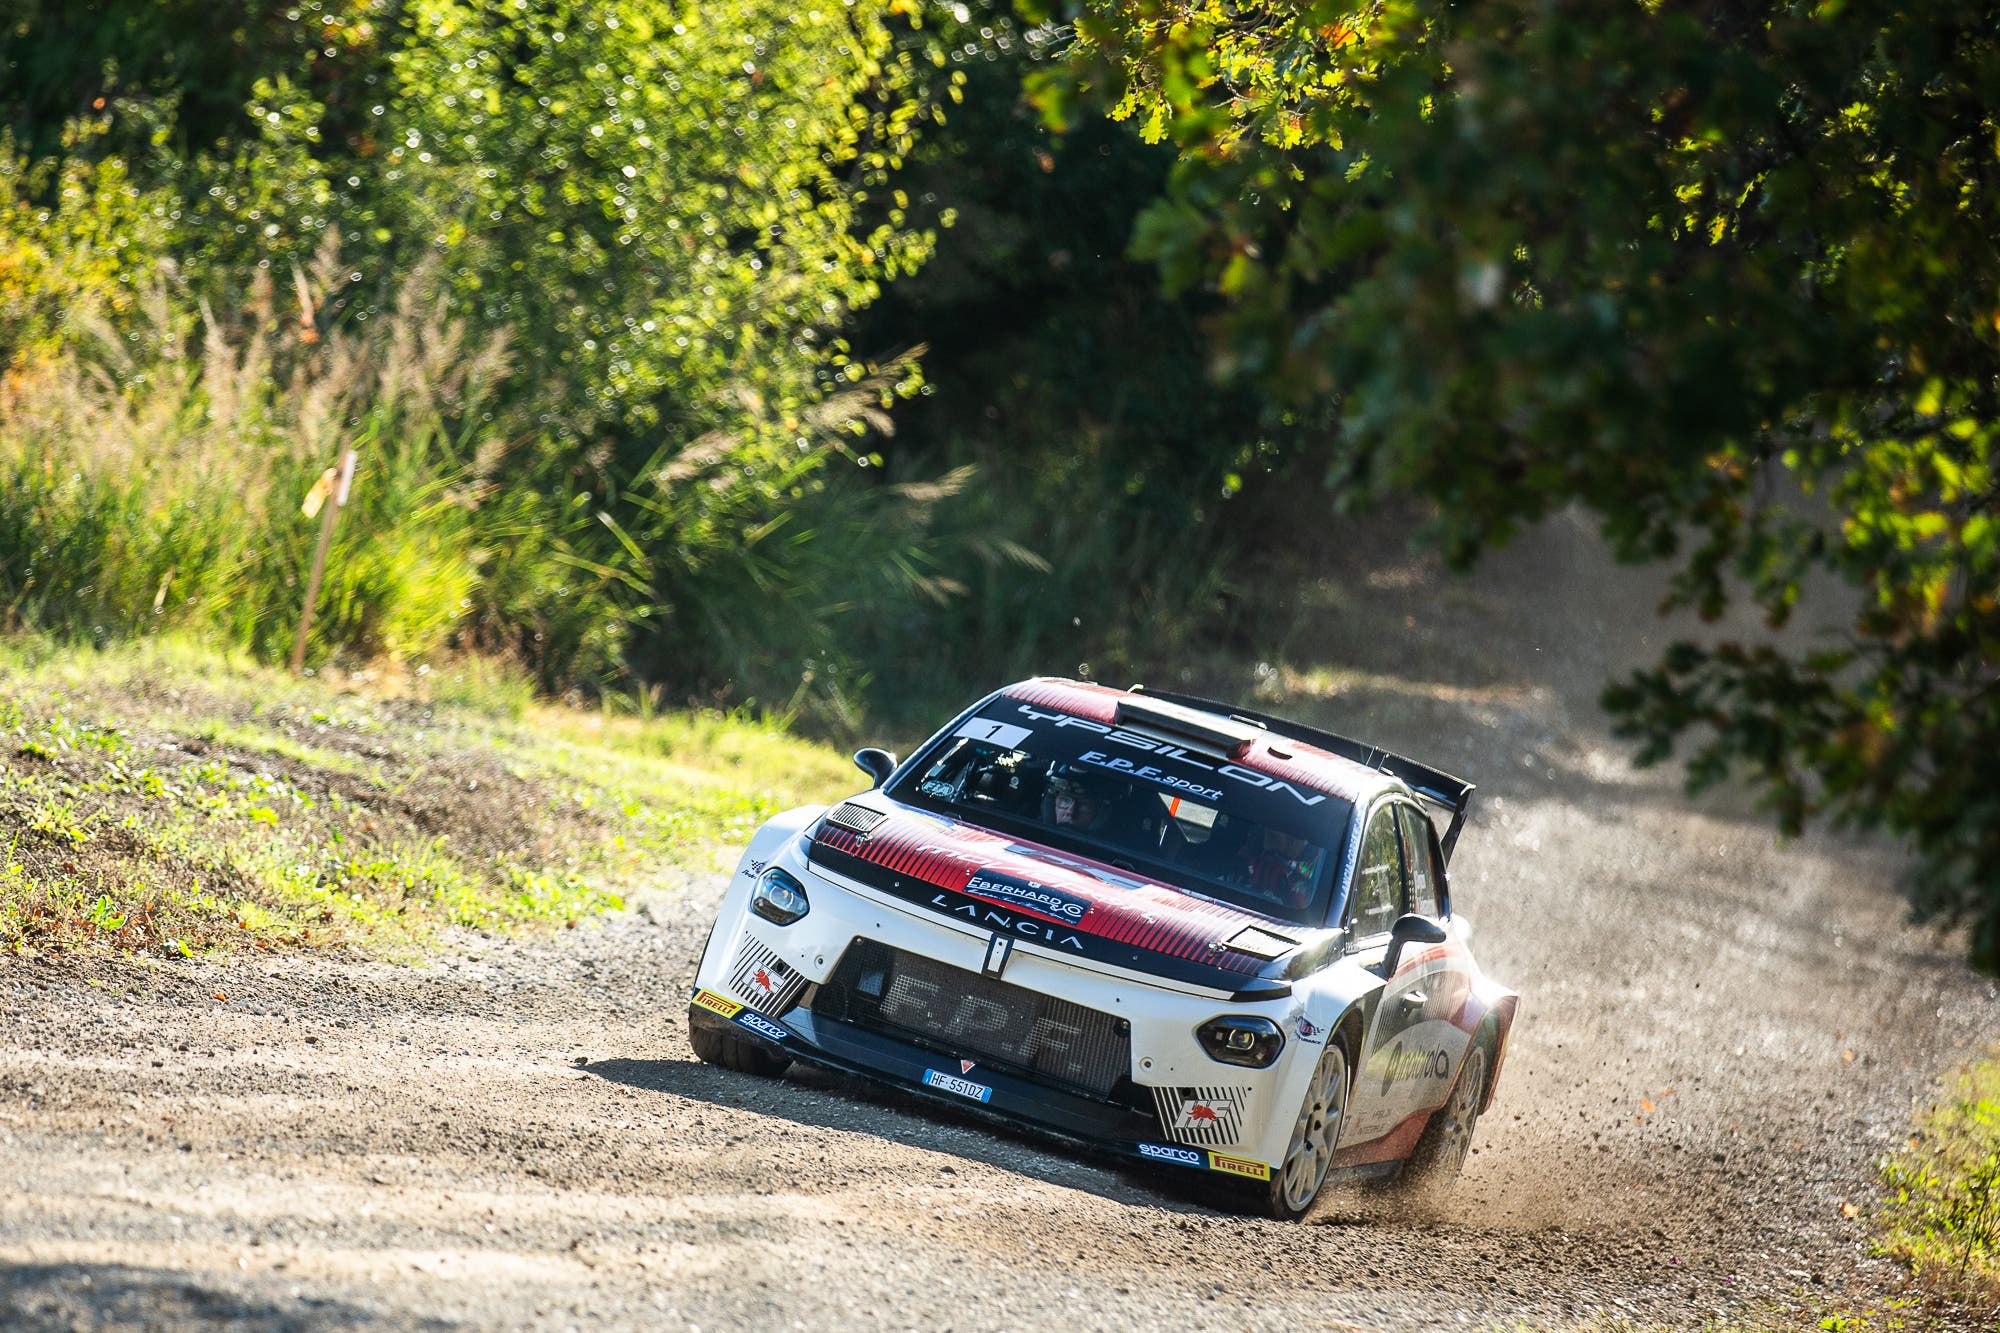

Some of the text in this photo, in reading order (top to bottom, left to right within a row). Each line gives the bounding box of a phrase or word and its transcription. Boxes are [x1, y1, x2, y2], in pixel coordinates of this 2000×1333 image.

[985, 724, 1003, 739] 1
[1018, 704, 1327, 806] YPSILON
[966, 876, 1062, 906] EBERHARD
[930, 893, 1084, 950] LANCIA
[696, 991, 738, 1015] PIRELLI
[739, 1013, 788, 1040] sparco
[1139, 1144, 1199, 1165] sparco
[1214, 1155, 1265, 1177] PIRELLI
